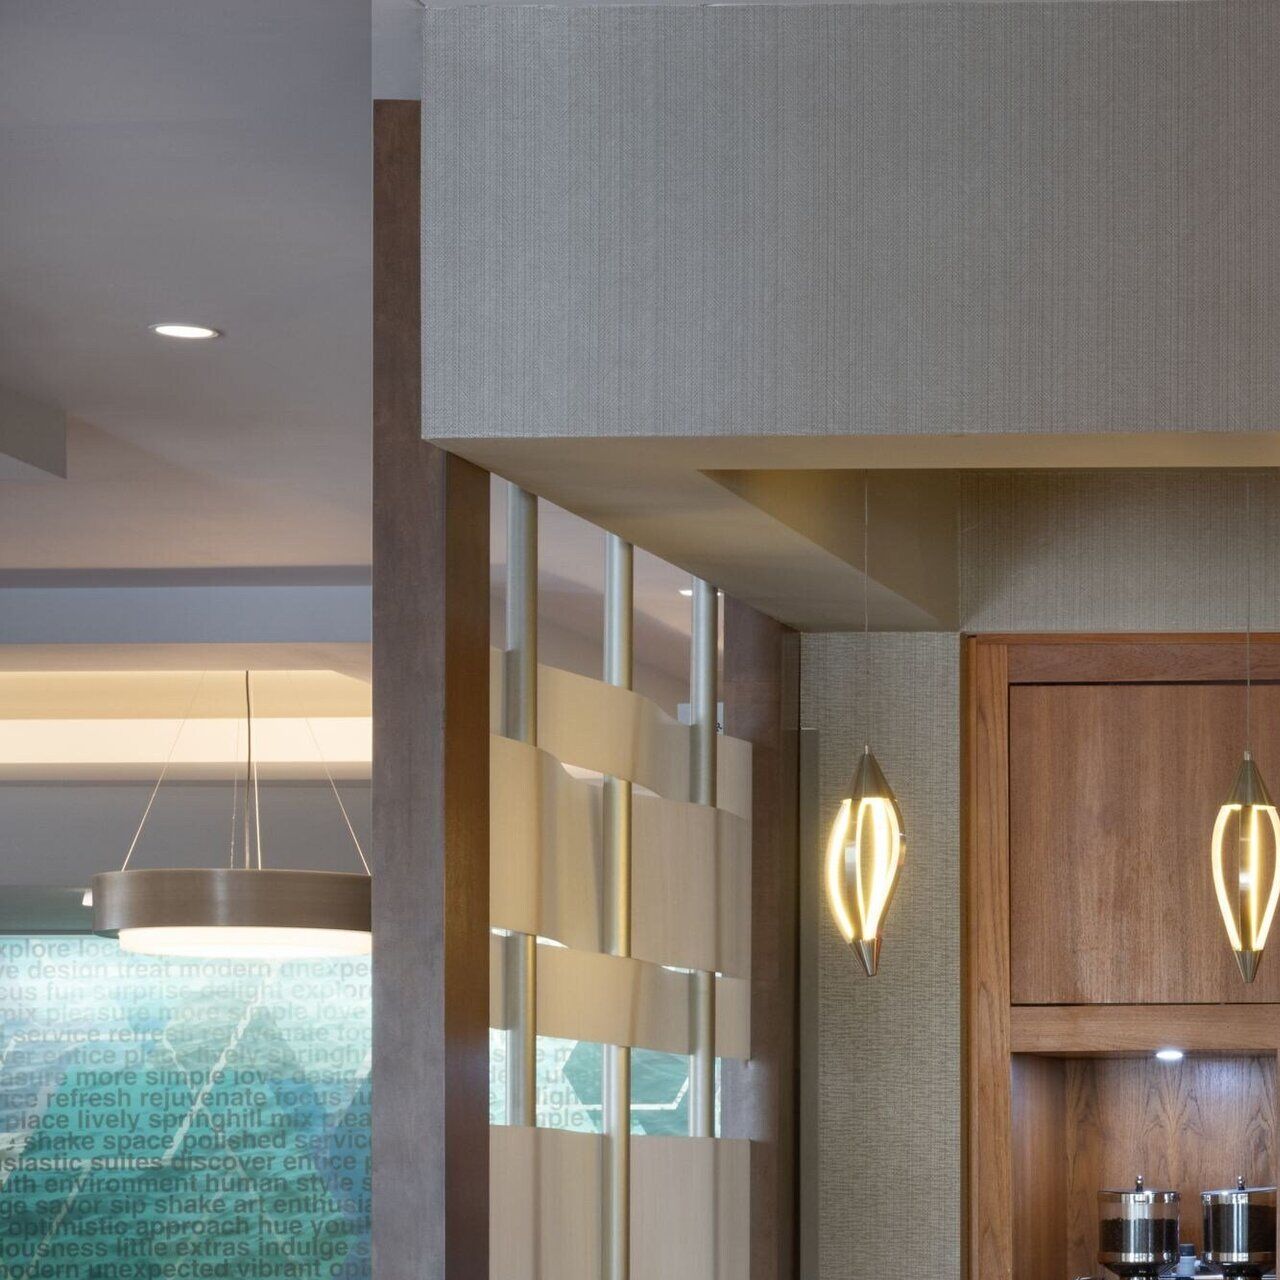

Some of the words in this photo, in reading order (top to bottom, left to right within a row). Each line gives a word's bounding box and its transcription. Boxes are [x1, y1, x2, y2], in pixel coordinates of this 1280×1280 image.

[28, 960, 108, 983] design
[119, 961, 172, 979] treat
[180, 959, 271, 979] modern
[94, 982, 192, 1004] surprise
[291, 981, 371, 1003] explor
[76, 1070, 137, 1086] more
[145, 1068, 225, 1090] simple
[234, 1067, 283, 1085] love
[47, 1088, 131, 1108] refresh
[140, 1087, 266, 1111] rejuvenate
[275, 1088, 341, 1107] focus
[78, 1109, 140, 1133] lively
[149, 1109, 262, 1133] springhill
[272, 1109, 313, 1128] mix
[24, 1131, 95, 1150] shake
[103, 1134, 174, 1154] space
[183, 1130, 286, 1154] polished
[295, 1131, 371, 1150] servic
[90, 1152, 163, 1172] suites
[171, 1152, 276, 1172] discover
[283, 1151, 357, 1171] entice
[44, 1174, 198, 1193] environment
[206, 1174, 288, 1193] human
[296, 1173, 354, 1197] style
[35, 1199, 100, 1215] savor
[110, 1196, 146, 1218] sip
[154, 1195, 226, 1214] shake
[234, 1195, 265, 1213] art
[8, 1216, 129, 1240] optimistic
[136, 1216, 249, 1239] approach
[259, 1215, 303, 1234] hue
[116, 1237, 168, 1257] little
[176, 1239, 250, 1257] extras
[259, 1236, 348, 1261] indulge
[238, 1258, 322, 1278] vibrant
